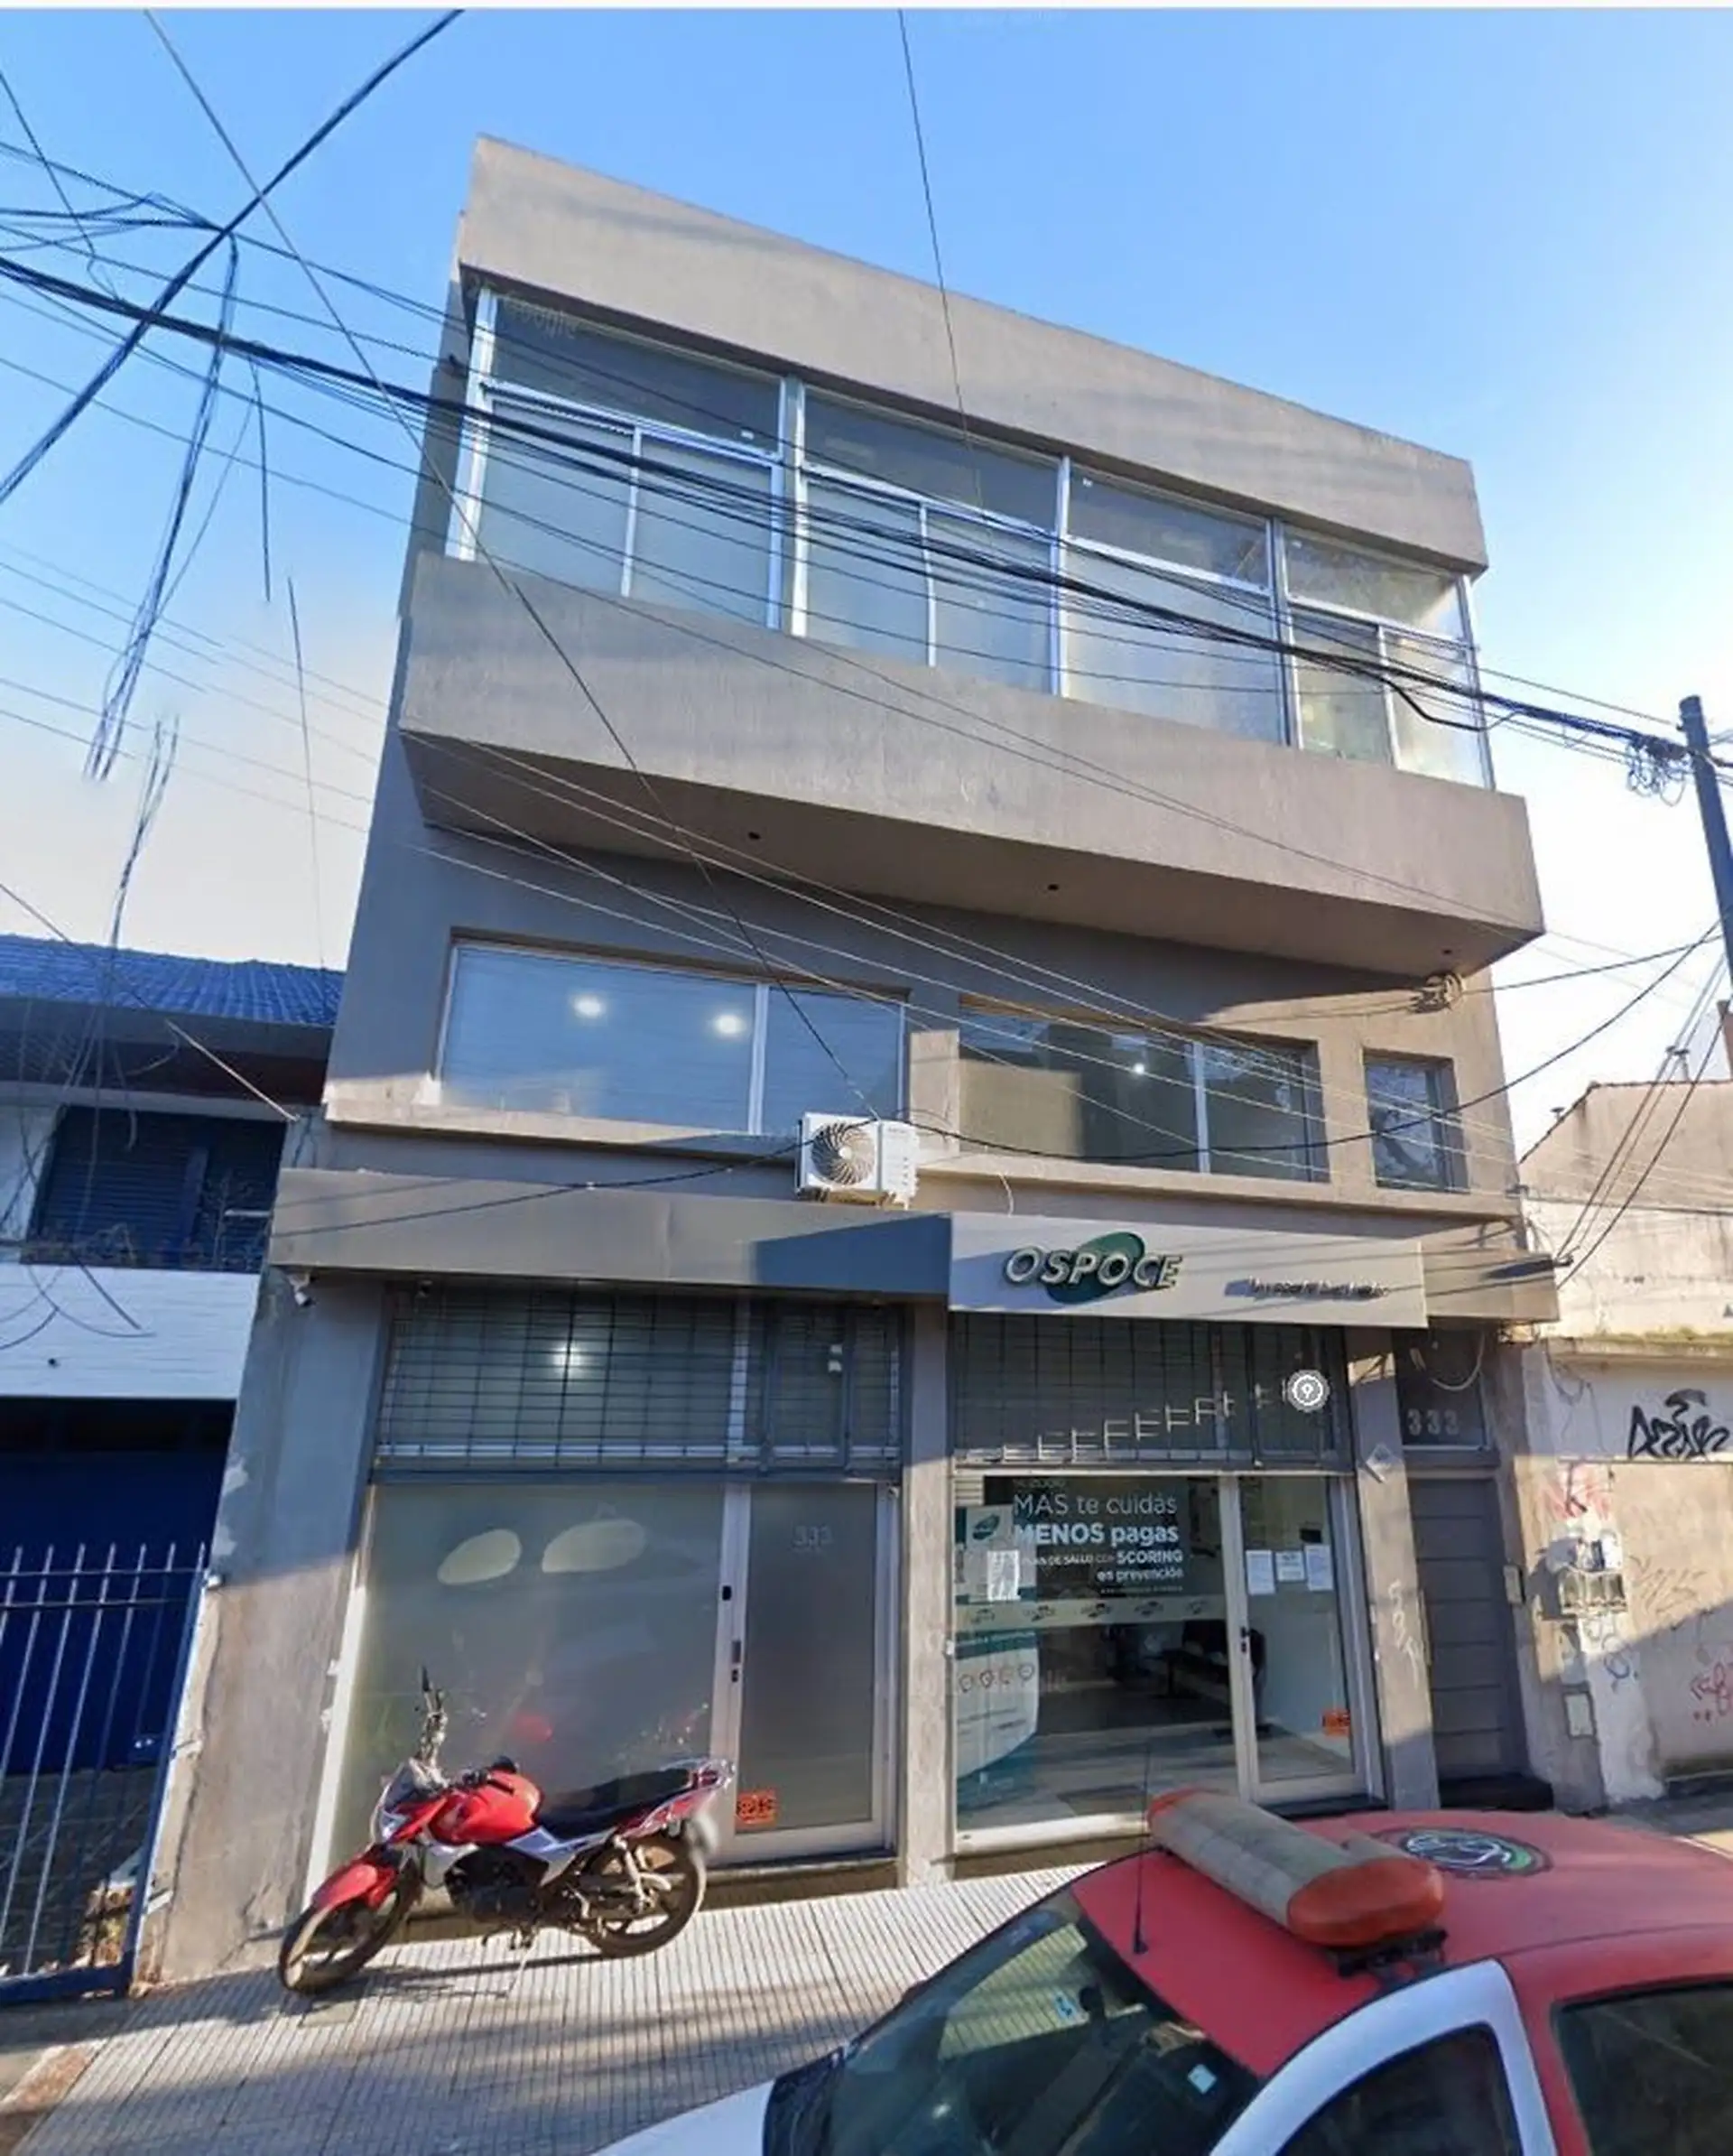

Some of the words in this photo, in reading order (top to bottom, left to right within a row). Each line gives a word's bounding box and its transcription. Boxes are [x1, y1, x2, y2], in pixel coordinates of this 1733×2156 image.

[1006, 1246, 1183, 1288] OSPOCE
[1408, 1408, 1459, 1436] 333
[1077, 1496, 1098, 1514] te
[1014, 1522, 1106, 1545] MENOS
[1110, 1526, 1179, 1547] pagas
[1117, 1549, 1184, 1564] SCORING
